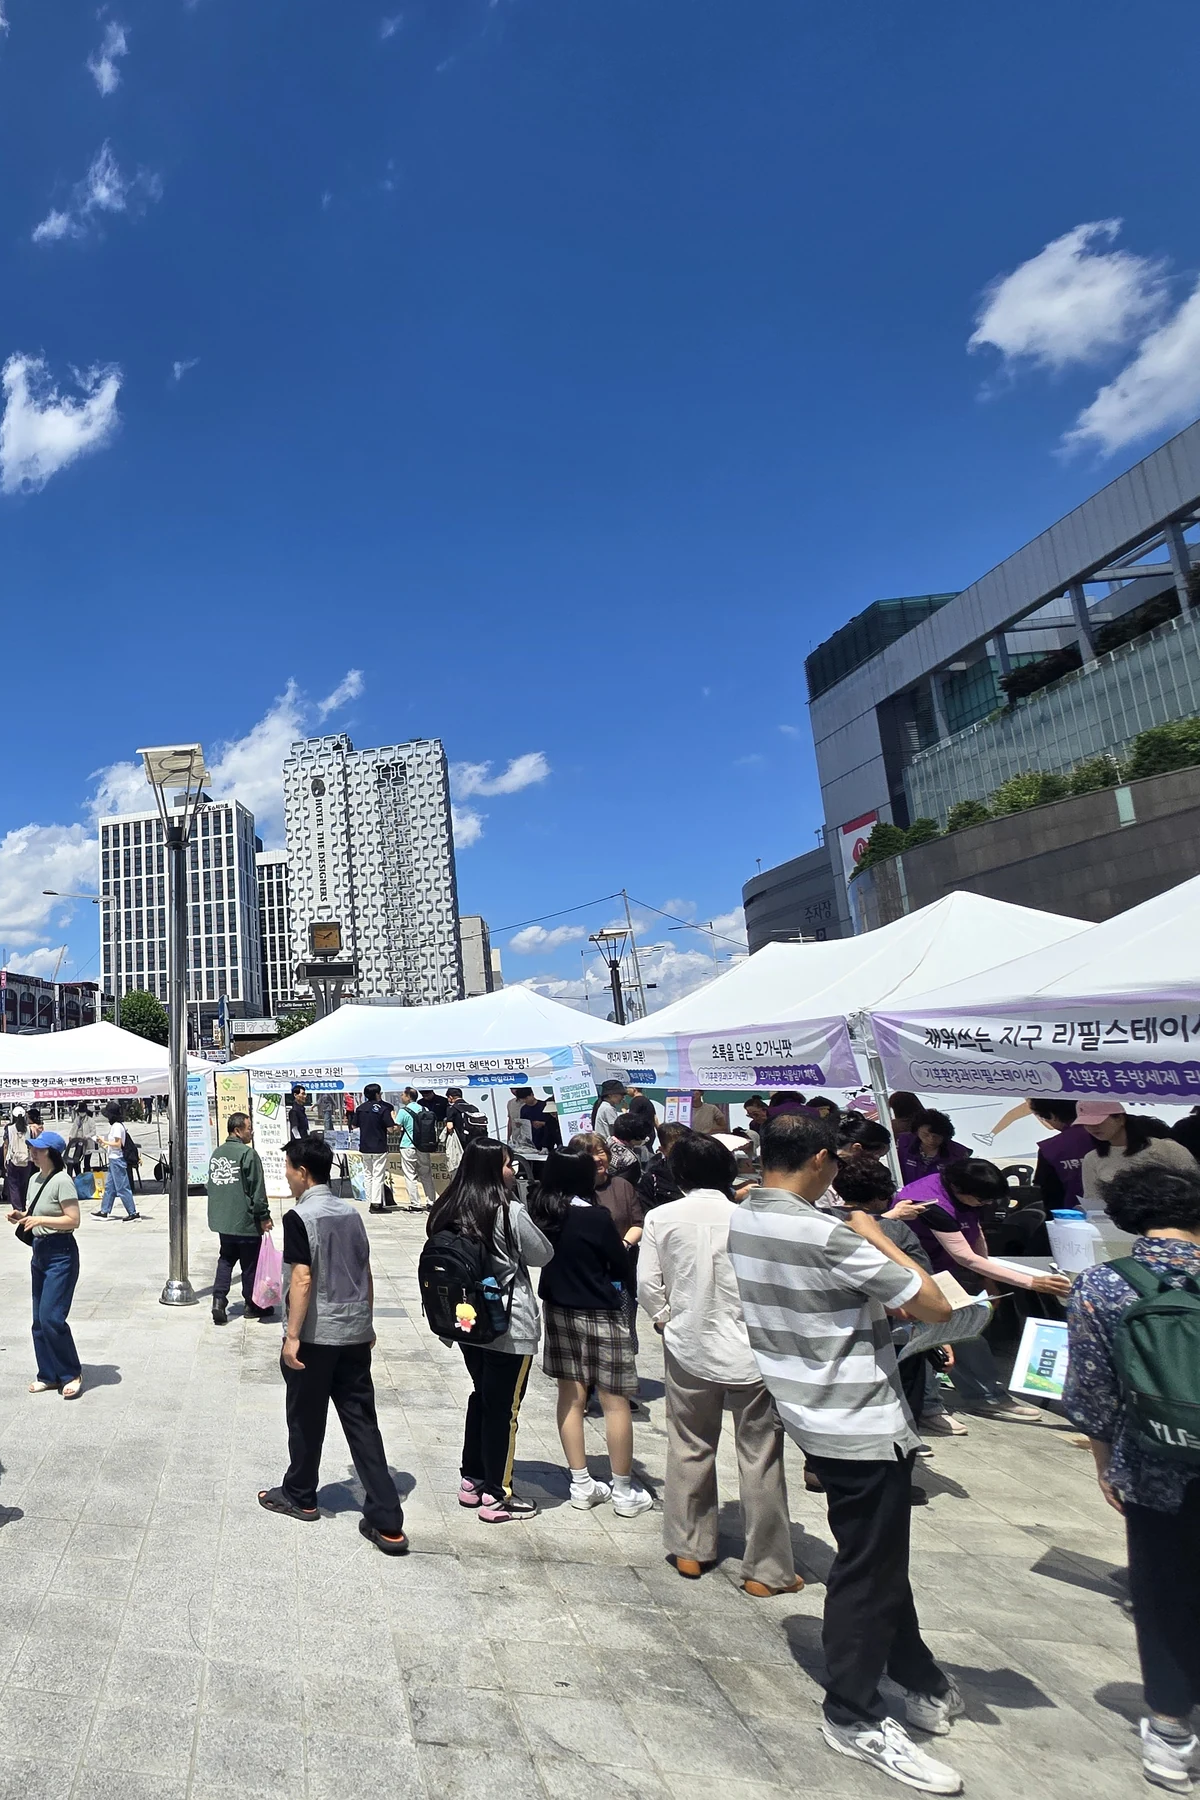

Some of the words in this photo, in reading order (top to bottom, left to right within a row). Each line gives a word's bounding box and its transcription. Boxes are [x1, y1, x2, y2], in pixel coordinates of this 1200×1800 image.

[314, 799, 324, 828] HOTEL
[316, 831, 325, 849] THE
[317, 851, 328, 902] DESIGNERS
[804, 900, 832, 923] 주차장
[924, 1027, 995, 1053] 채워쓰는
[999, 1024, 1043, 1050] 지구
[711, 1042, 735, 1062] 초록을
[735, 1041, 753, 1061] 담은
[755, 1038, 793, 1058] 오가닉팟
[300, 1068, 322, 1078] 모으면
[324, 1066, 344, 1077] 자원!
[405, 1063, 433, 1073] 에너지
[435, 1061, 467, 1072] 아끼면
[468, 1059, 500, 1071] 혜택이
[503, 1057, 530, 1071] 팡팡!
[69, 1077, 101, 1086] 변화하는
[104, 1075, 139, 1085] 동대문구!
[759, 1069, 782, 1082] 오가닉팟
[782, 1068, 804, 1082] 식물심기
[923, 1067, 1042, 1086] 기후환경과(리필스테이션)
[1067, 1069, 1110, 1088] 친환경
[1115, 1069, 1181, 1089] 주방세제
[1060, 1157, 1084, 1171] 기후
